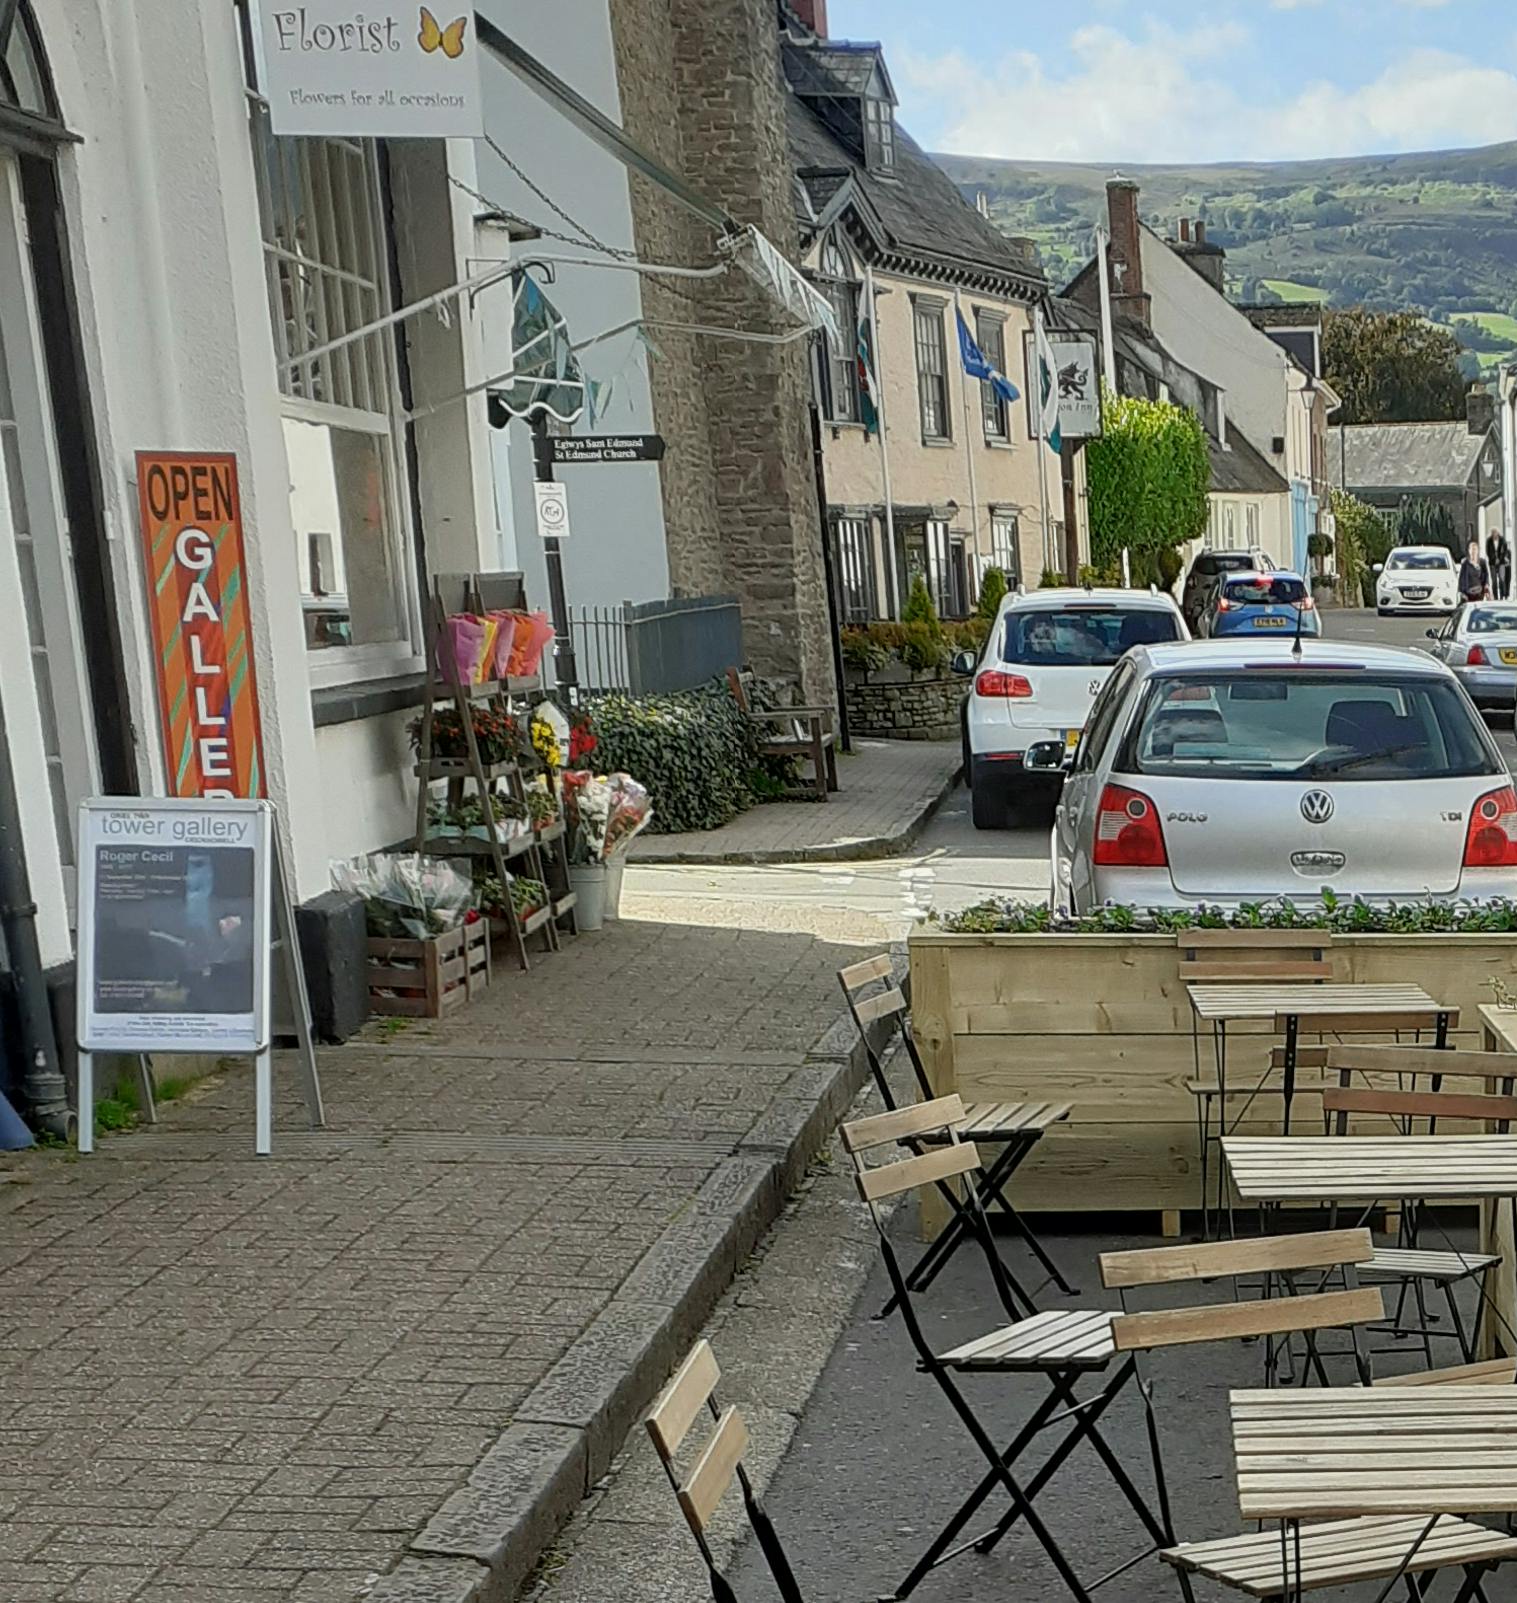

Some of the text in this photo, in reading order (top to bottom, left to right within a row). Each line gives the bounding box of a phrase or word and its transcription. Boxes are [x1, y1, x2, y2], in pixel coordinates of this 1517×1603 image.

[272, 7, 401, 54] Florist
[289, 88, 465, 108] Flowers for all occasions
[606, 438, 644, 448] Edmund
[554, 450, 637, 460] St Edmund Church
[148, 464, 234, 522] OPEN
[1167, 812, 1208, 822] POLO
[102, 816, 248, 841] tower gallery
[100, 850, 174, 862] Roger Cecil
